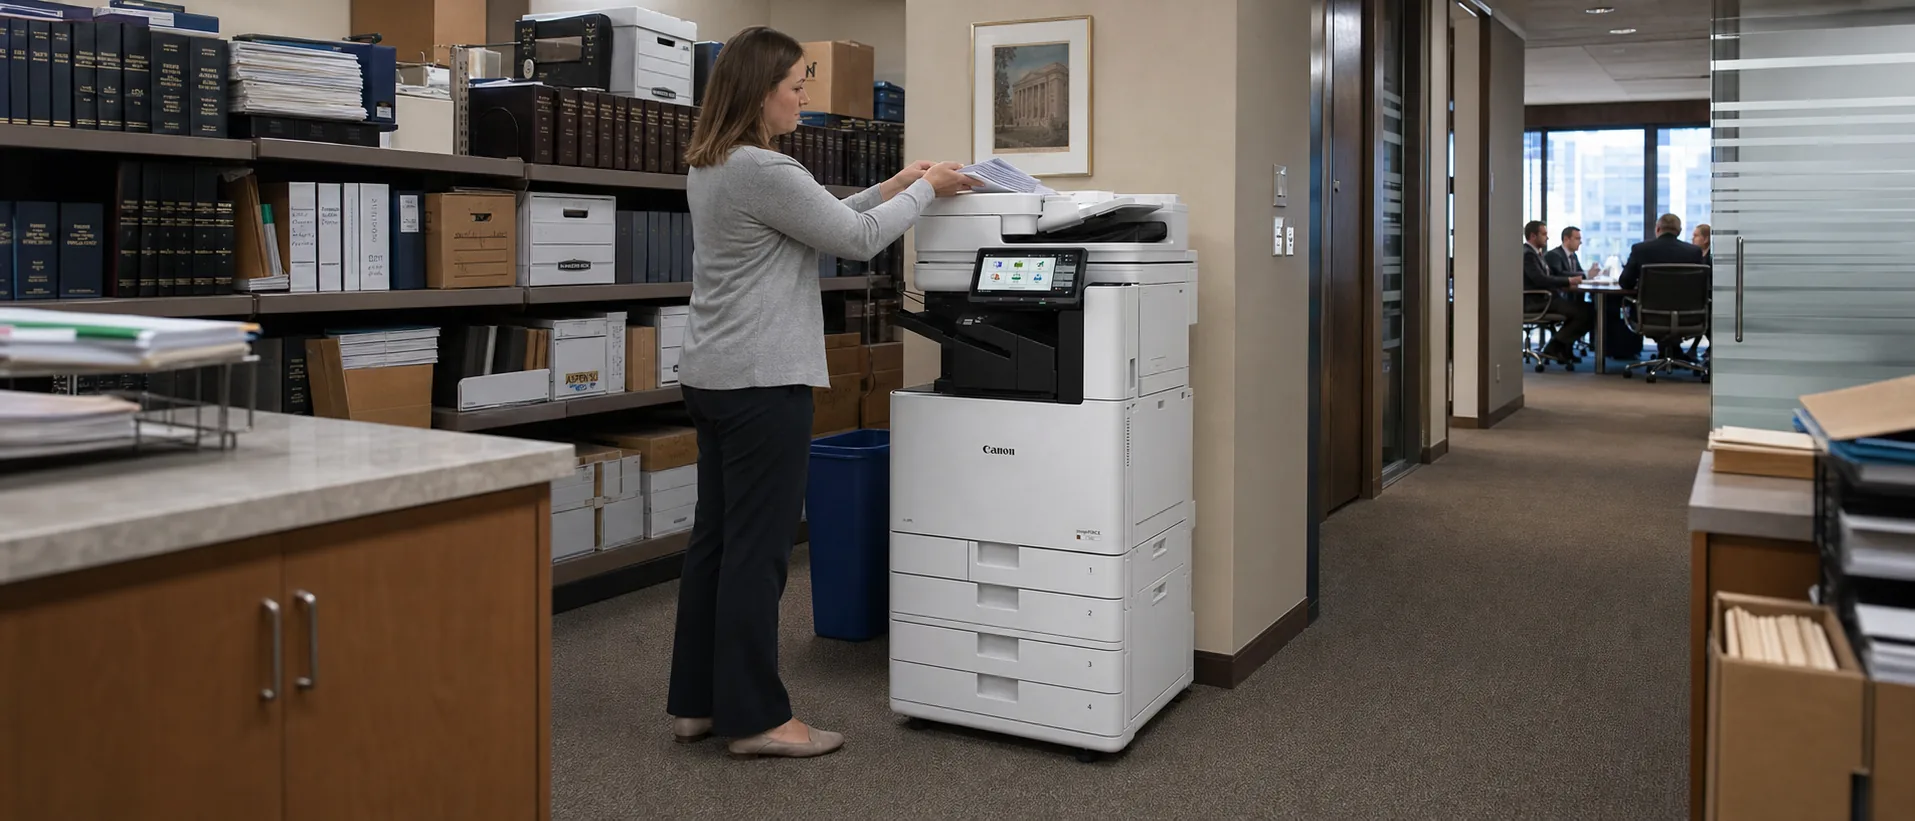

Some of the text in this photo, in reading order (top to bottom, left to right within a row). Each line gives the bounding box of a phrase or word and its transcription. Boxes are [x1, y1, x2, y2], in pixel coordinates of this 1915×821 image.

[982, 444, 1015, 456] Canon
[1088, 566, 1093, 574] 1
[1087, 609, 1093, 617] 2
[1087, 660, 1093, 668] 3
[1087, 703, 1093, 711] 4
